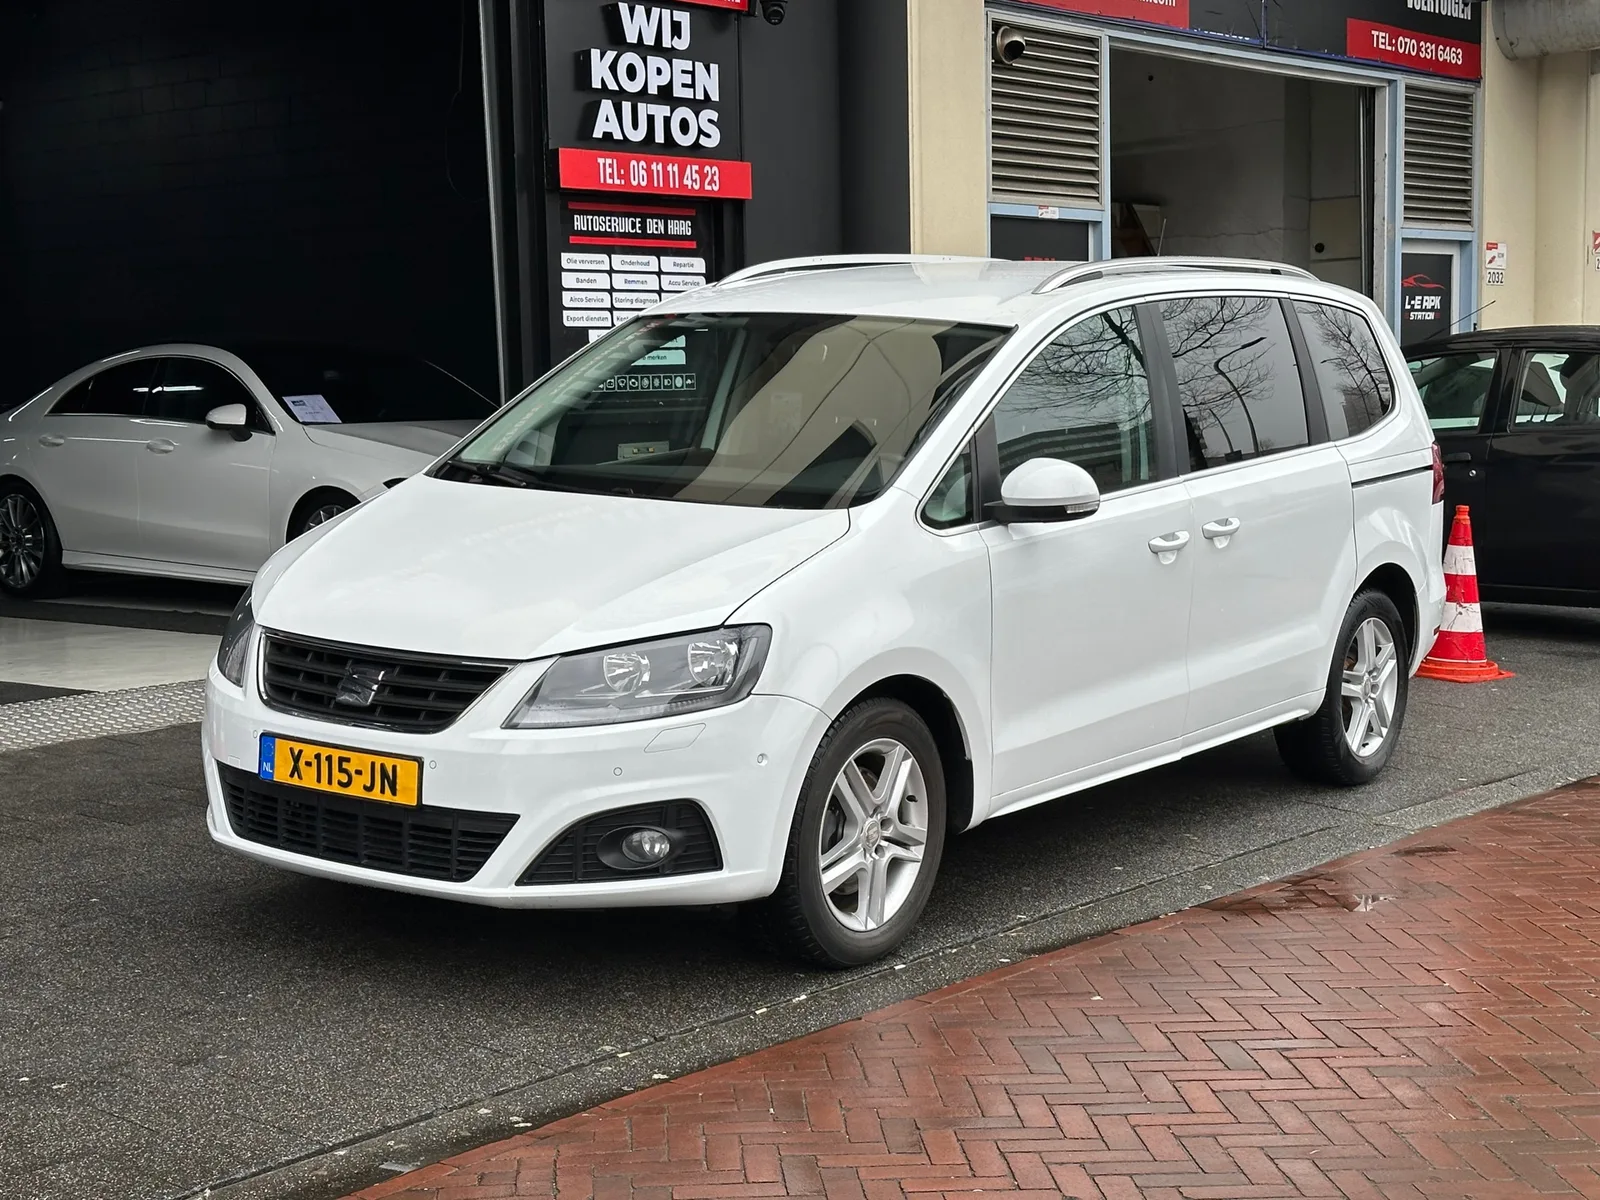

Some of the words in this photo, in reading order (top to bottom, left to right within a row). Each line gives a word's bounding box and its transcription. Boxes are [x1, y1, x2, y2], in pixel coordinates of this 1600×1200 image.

[618, 1, 691, 51] WIJ
[1371, 29, 1395, 52] TEL:
[1397, 36, 1417, 57] 070
[1419, 40, 1436, 60] 331
[1437, 44, 1463, 65] 6463
[590, 48, 720, 102] KOPEN
[592, 99, 721, 148] AUTOS
[597, 157, 625, 185] TEL:
[630, 159, 648, 187] 06
[651, 161, 664, 188] 11
[667, 163, 679, 189] 11
[683, 164, 700, 191] 45
[704, 165, 720, 192] 23
[646, 218, 665, 235] DEN
[667, 219, 692, 236] HAAG
[566, 257, 578, 265] Olie
[620, 259, 650, 267] Onderhoud
[668, 279, 681, 287] Accu
[682, 279, 700, 287] Service
[1487, 271, 1504, 284] 2032
[614, 296, 634, 305] Storing
[634, 296, 658, 305] diagnose
[1422, 295, 1442, 310] APK
[566, 315, 585, 323] Export
[1409, 311, 1435, 320] STATION
[262, 761, 273, 773] NL
[288, 746, 398, 797] X-115-JN
